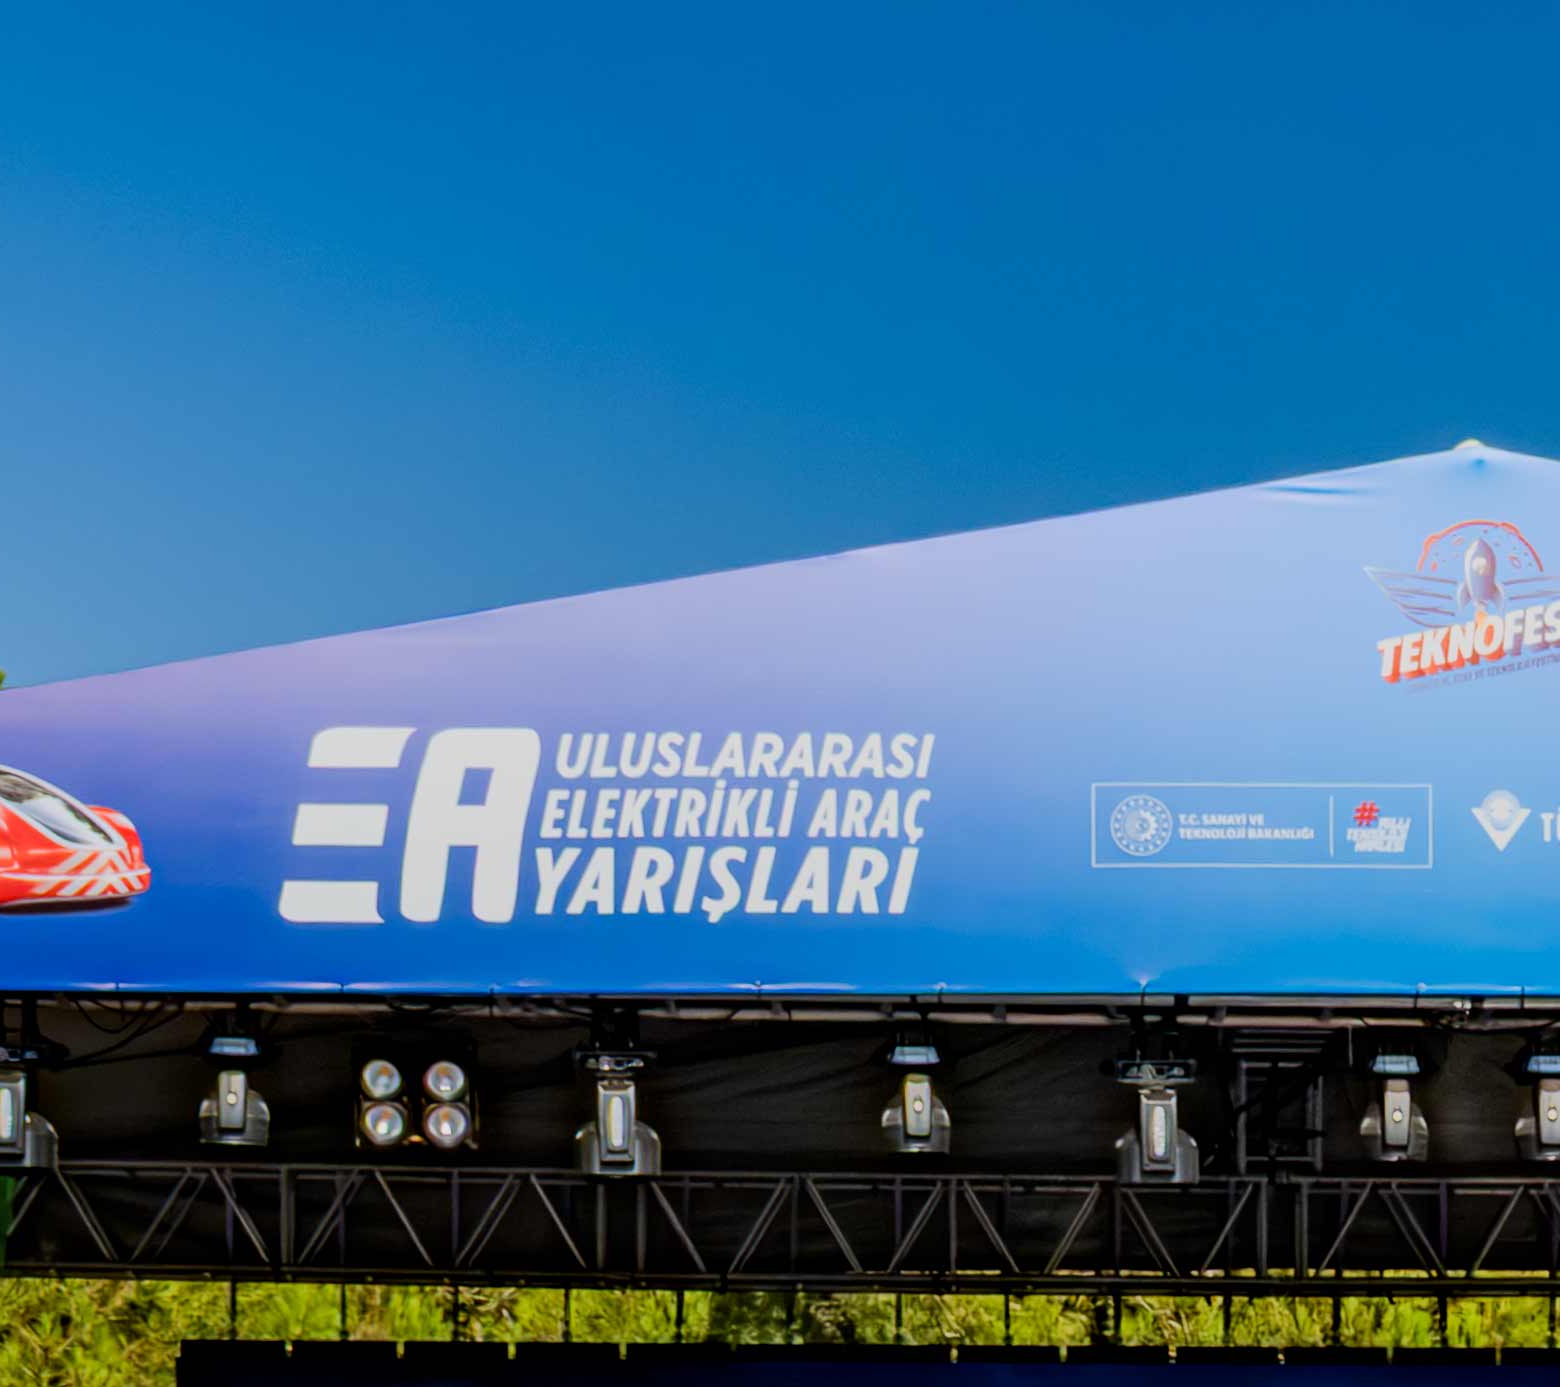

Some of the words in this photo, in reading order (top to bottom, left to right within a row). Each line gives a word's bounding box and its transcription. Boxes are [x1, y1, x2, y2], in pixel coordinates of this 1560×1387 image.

[556, 732, 934, 778] ULUSLARARASI
[540, 779, 797, 838] ELEKTRİKLİ
[808, 788, 929, 844] ARAÇ
[534, 846, 919, 923] YARIŞLARI
